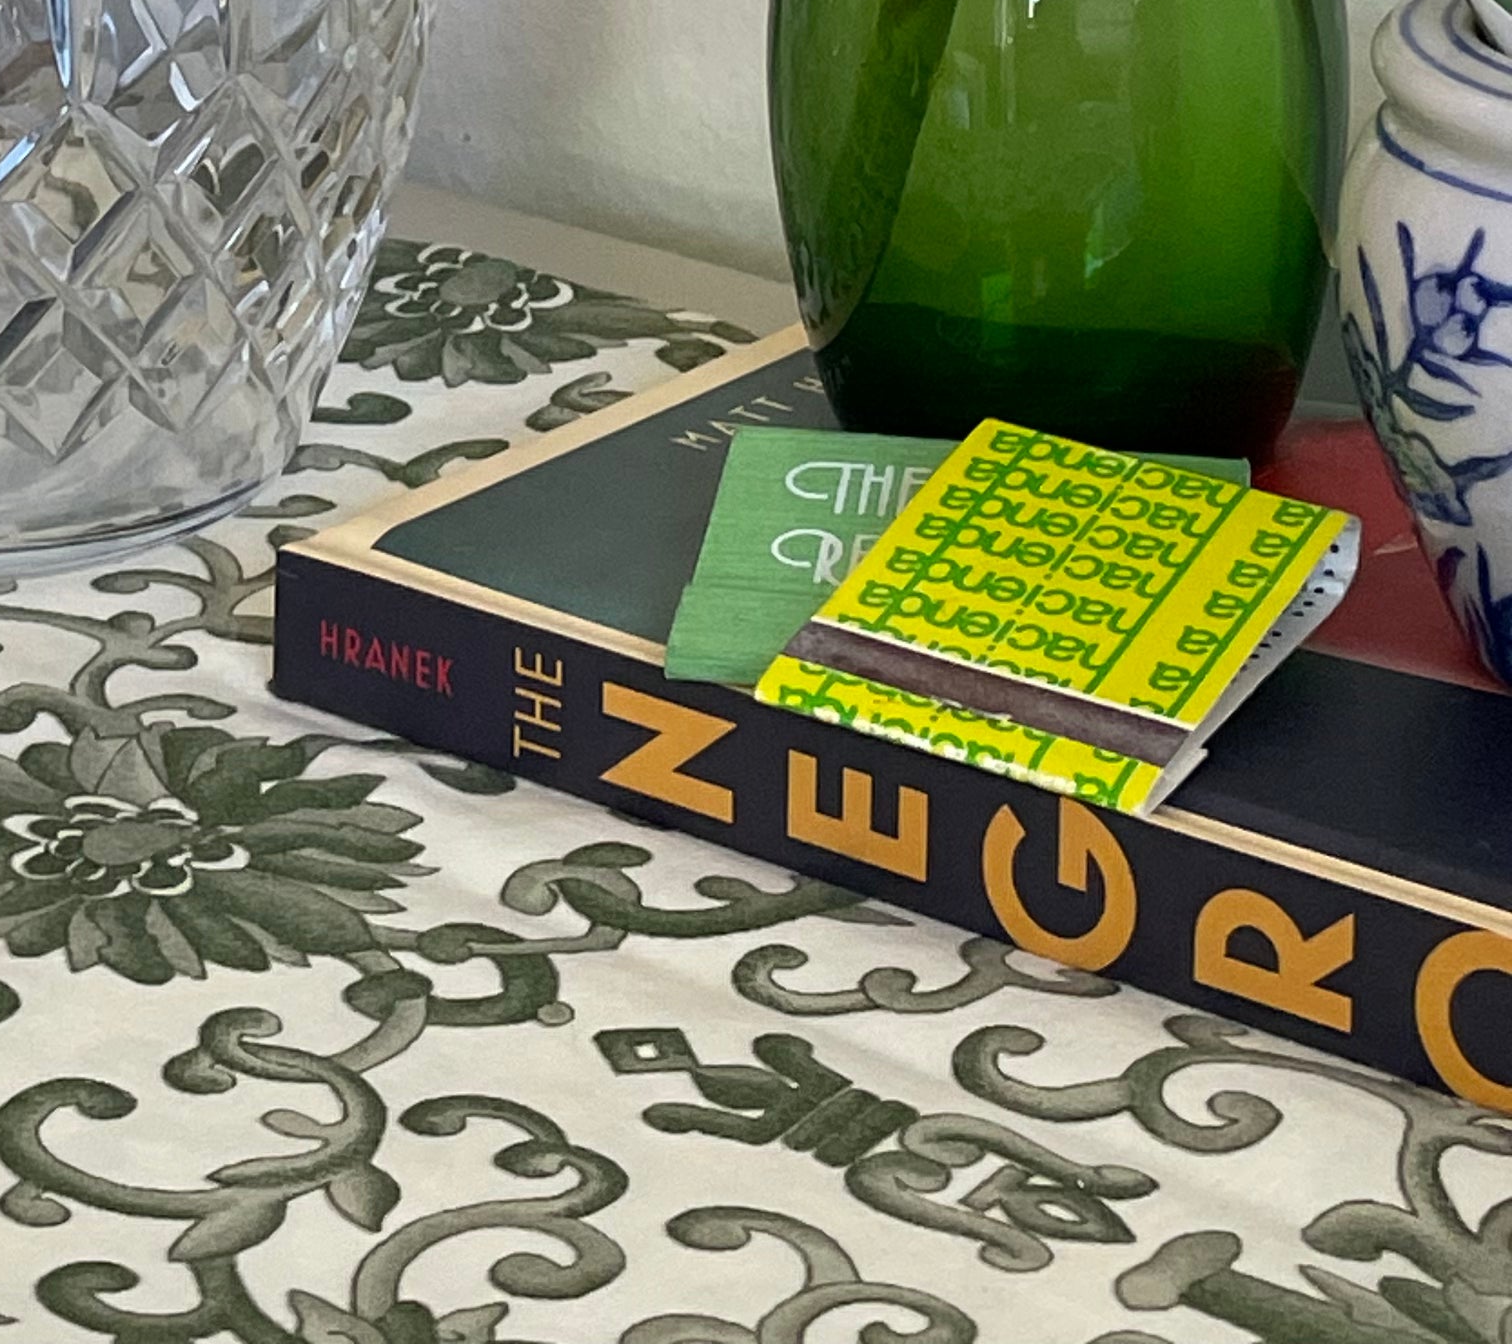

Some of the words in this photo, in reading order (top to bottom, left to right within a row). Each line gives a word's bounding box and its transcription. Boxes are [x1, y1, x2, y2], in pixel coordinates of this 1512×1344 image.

[669, 395, 794, 452] MATT
[785, 461, 930, 517] THE
[964, 457, 1224, 562] hacienda
[990, 430, 1248, 530] hacienda
[915, 514, 1180, 624] hacienda
[940, 485, 1203, 592] hacienda
[858, 580, 1128, 692] hacienda
[886, 546, 1156, 658] hacienda
[319, 619, 455, 697] HRANEK
[513, 646, 563, 760] THE
